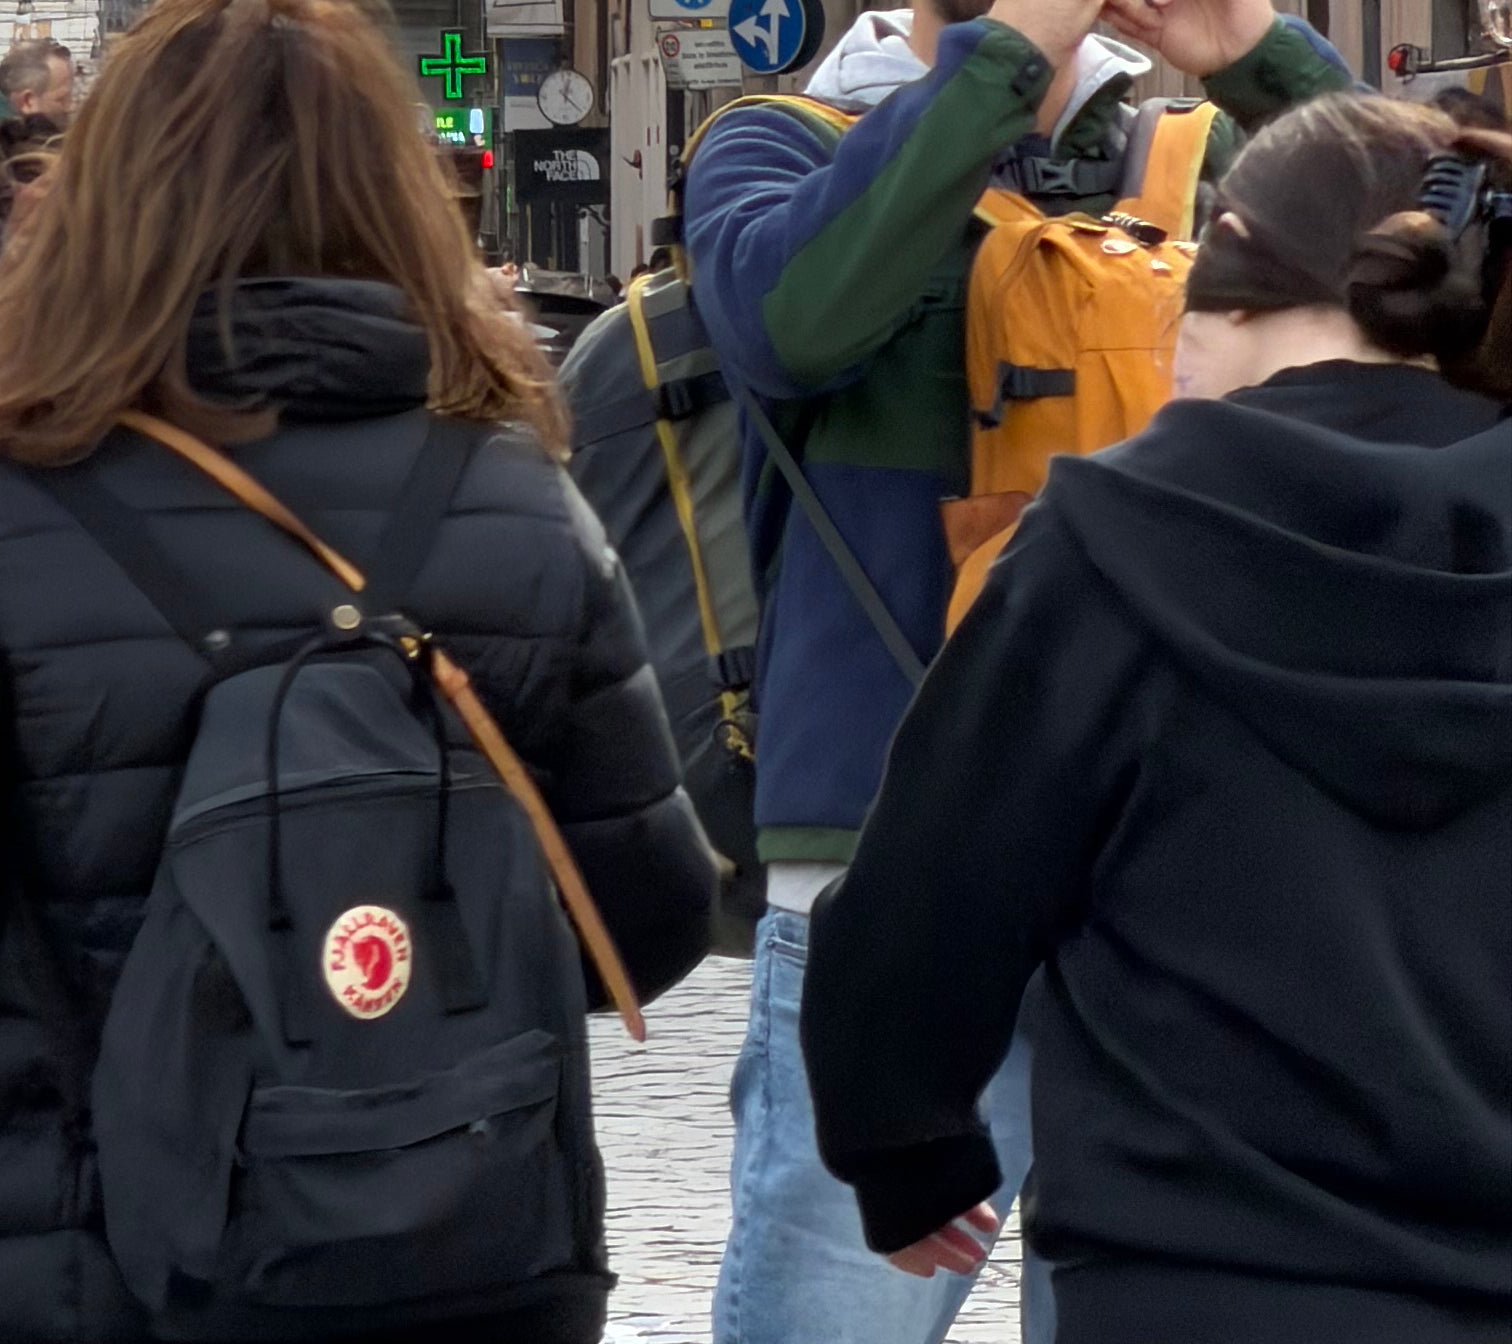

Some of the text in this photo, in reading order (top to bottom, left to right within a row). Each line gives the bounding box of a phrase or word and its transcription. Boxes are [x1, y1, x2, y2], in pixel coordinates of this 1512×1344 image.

[552, 150, 576, 161] THE
[534, 160, 577, 173] NORTH
[546, 171, 577, 182] FACE
